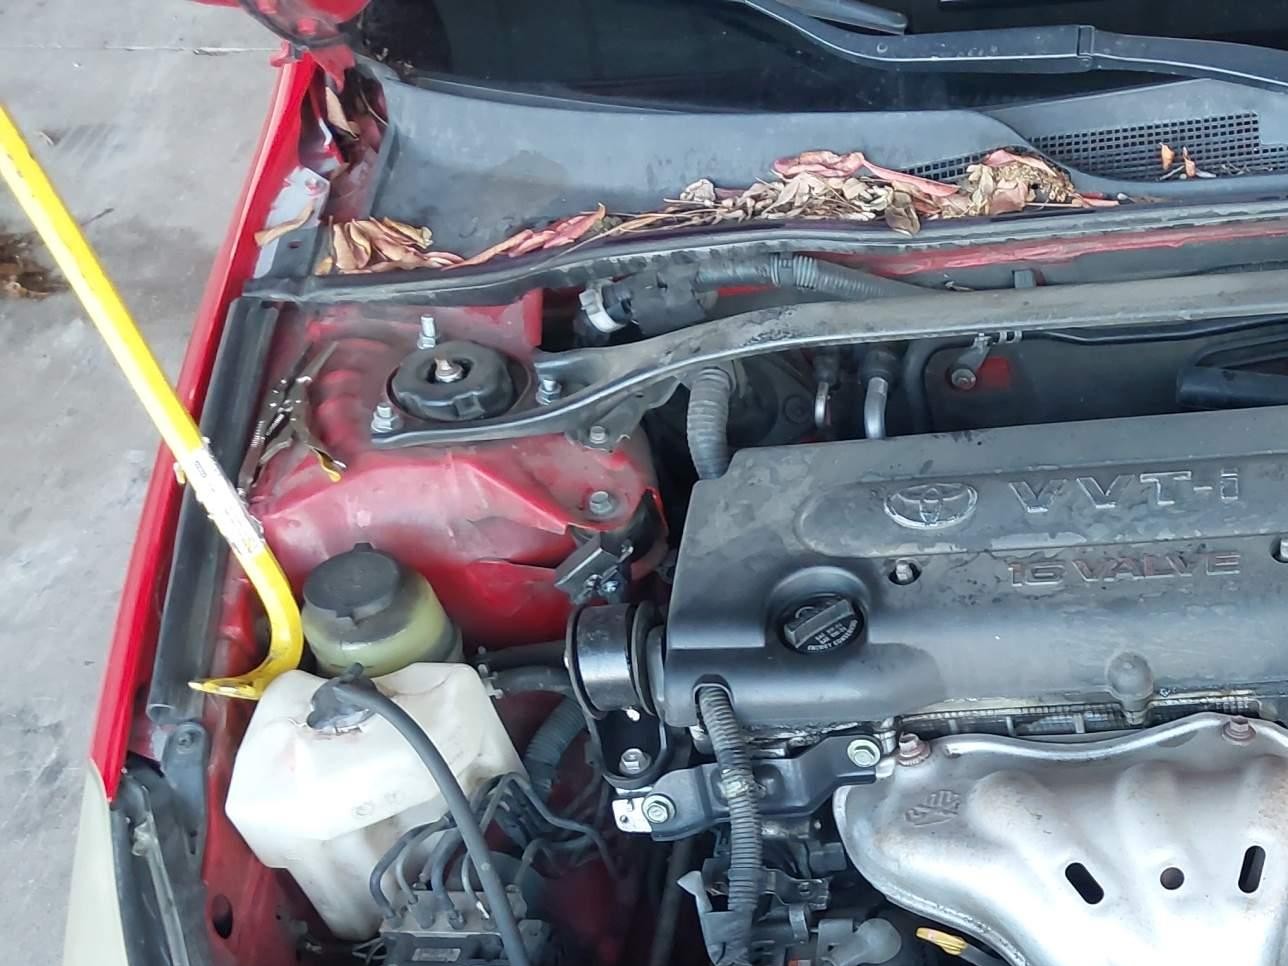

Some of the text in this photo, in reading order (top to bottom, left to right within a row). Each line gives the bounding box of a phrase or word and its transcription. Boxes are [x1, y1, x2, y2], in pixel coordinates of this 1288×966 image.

[1008, 468, 1239, 512] VVT-i
[1007, 552, 1241, 587] 16 VALVE
